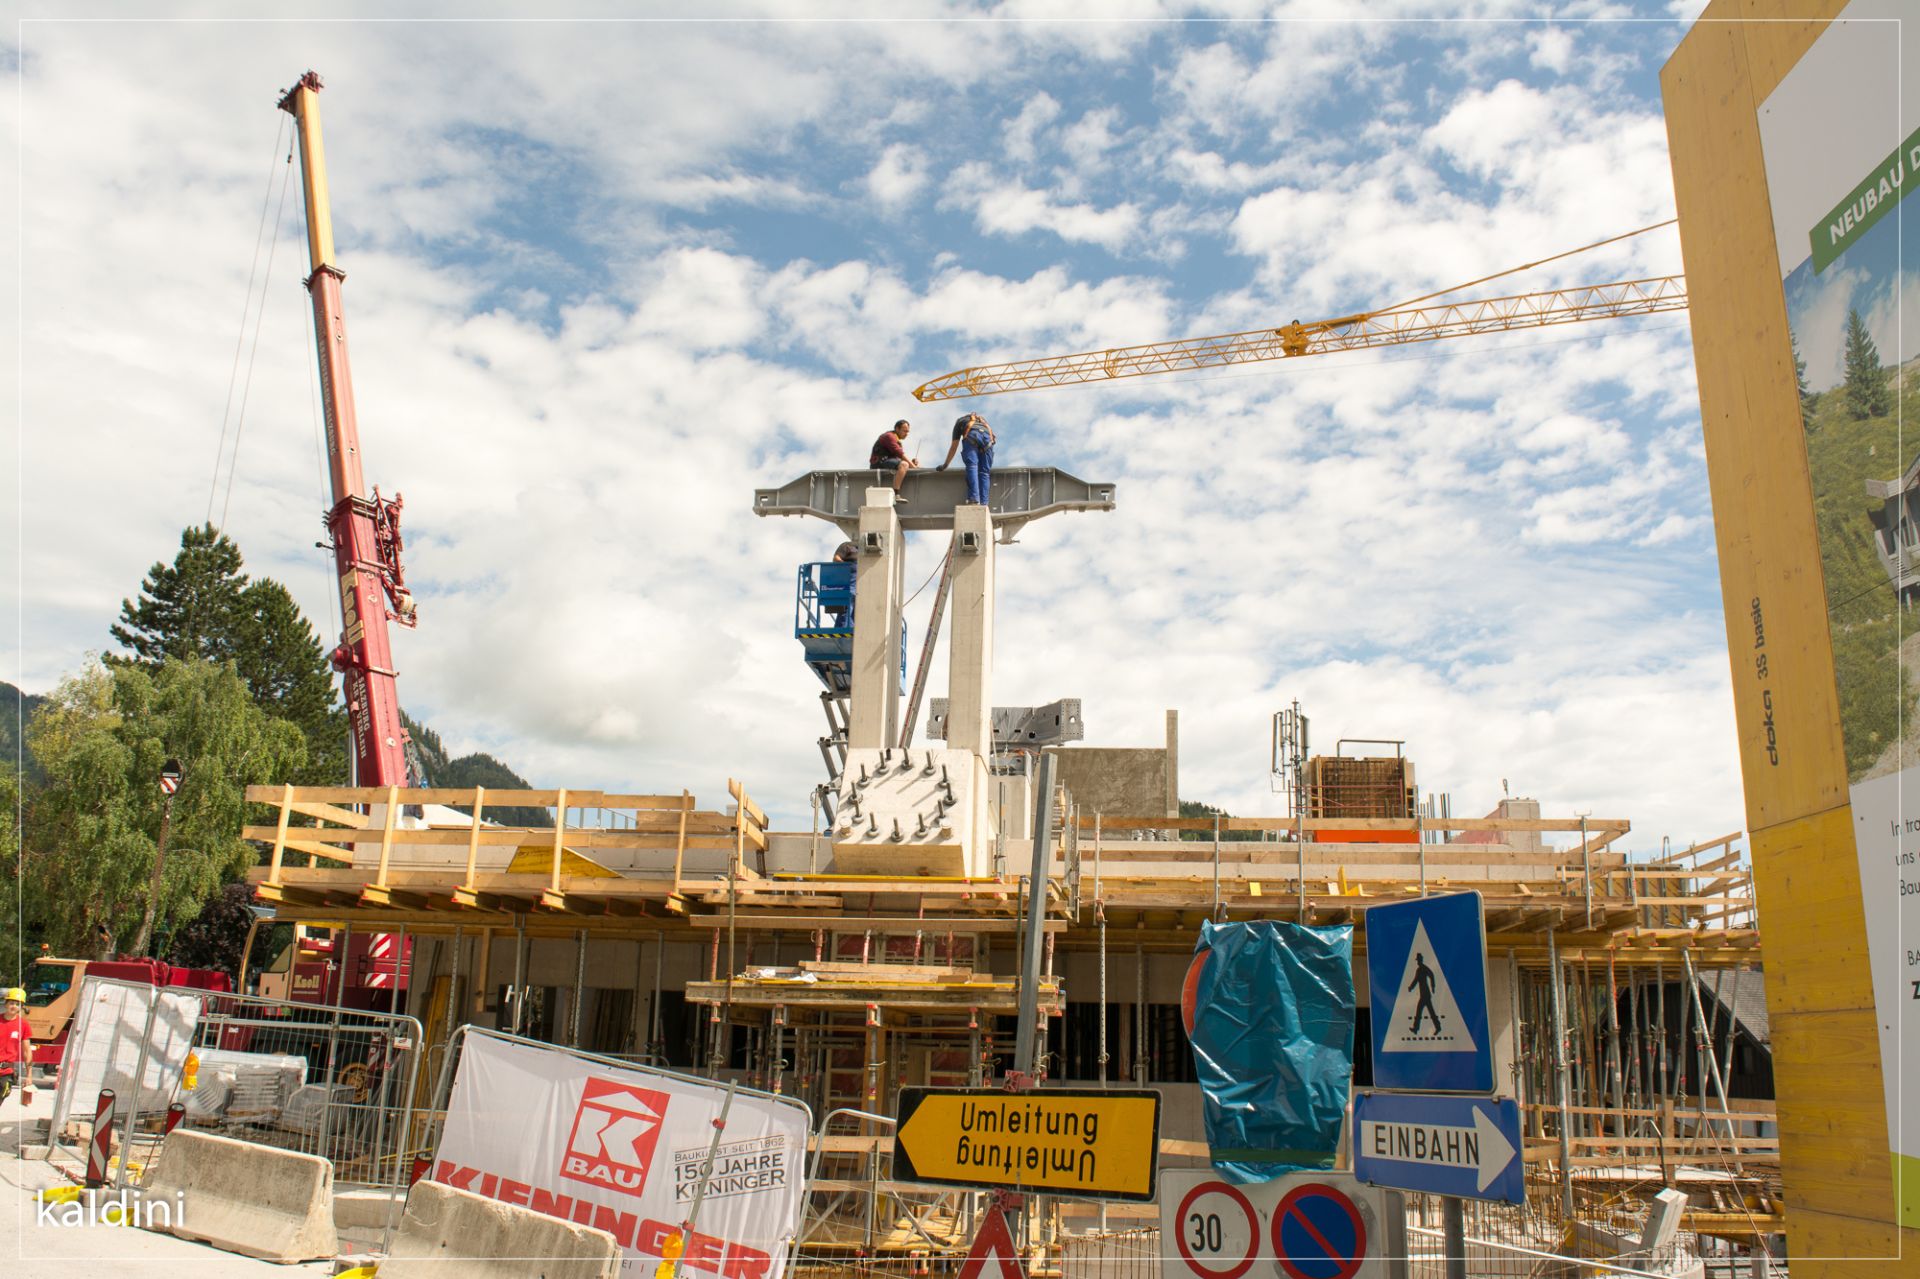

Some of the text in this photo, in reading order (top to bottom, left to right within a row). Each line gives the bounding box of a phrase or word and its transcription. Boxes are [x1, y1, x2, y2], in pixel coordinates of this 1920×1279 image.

[1829, 160, 1905, 246] NEUBAU
[341, 566, 365, 645] Knoll
[1750, 596, 1778, 767] doka 3S basic
[1895, 852, 1915, 867] uns
[294, 974, 320, 989] Knoll
[960, 1102, 1099, 1145] Umleitung
[718, 1152, 784, 1176] JAHRE
[732, 1143, 754, 1153] SEIT
[760, 1137, 785, 1149] 1862
[956, 1135, 1096, 1183] Umleitung
[1374, 1124, 1480, 1166] EINBAHN
[565, 1156, 642, 1189] BAU
[1189, 1212, 1223, 1253] 30
